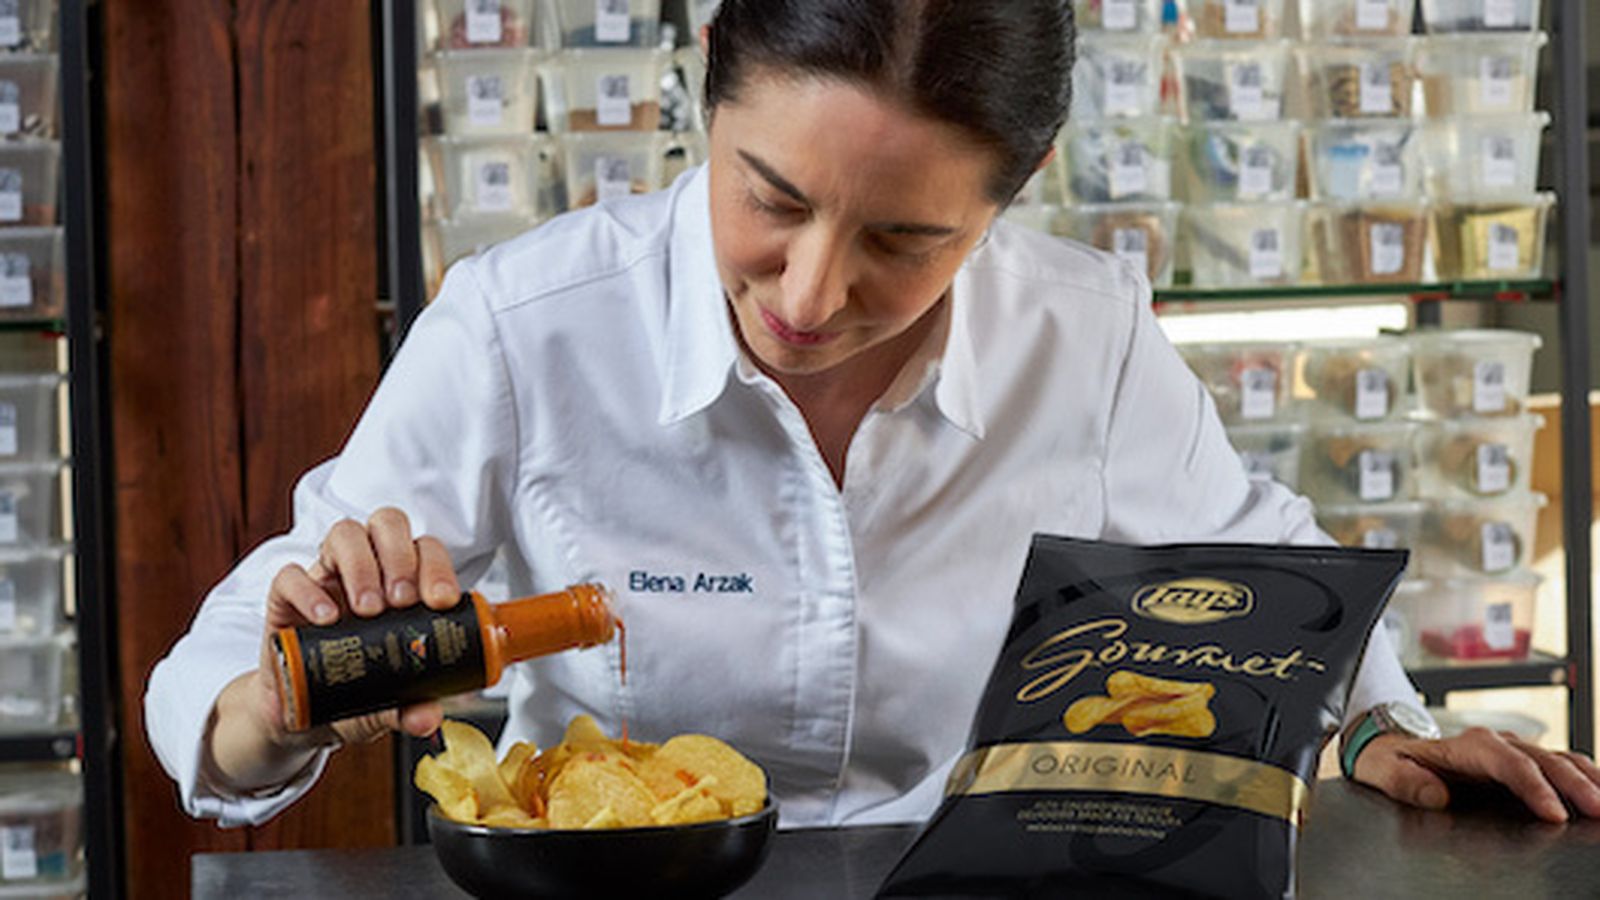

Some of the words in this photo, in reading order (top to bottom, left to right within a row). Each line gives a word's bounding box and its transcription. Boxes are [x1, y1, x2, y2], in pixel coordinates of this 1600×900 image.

[629, 571, 685, 592] Elena
[693, 572, 753, 592] Arzak
[1016, 618, 1326, 702] Gourmet
[1032, 754, 1196, 784] ORIGINAL
